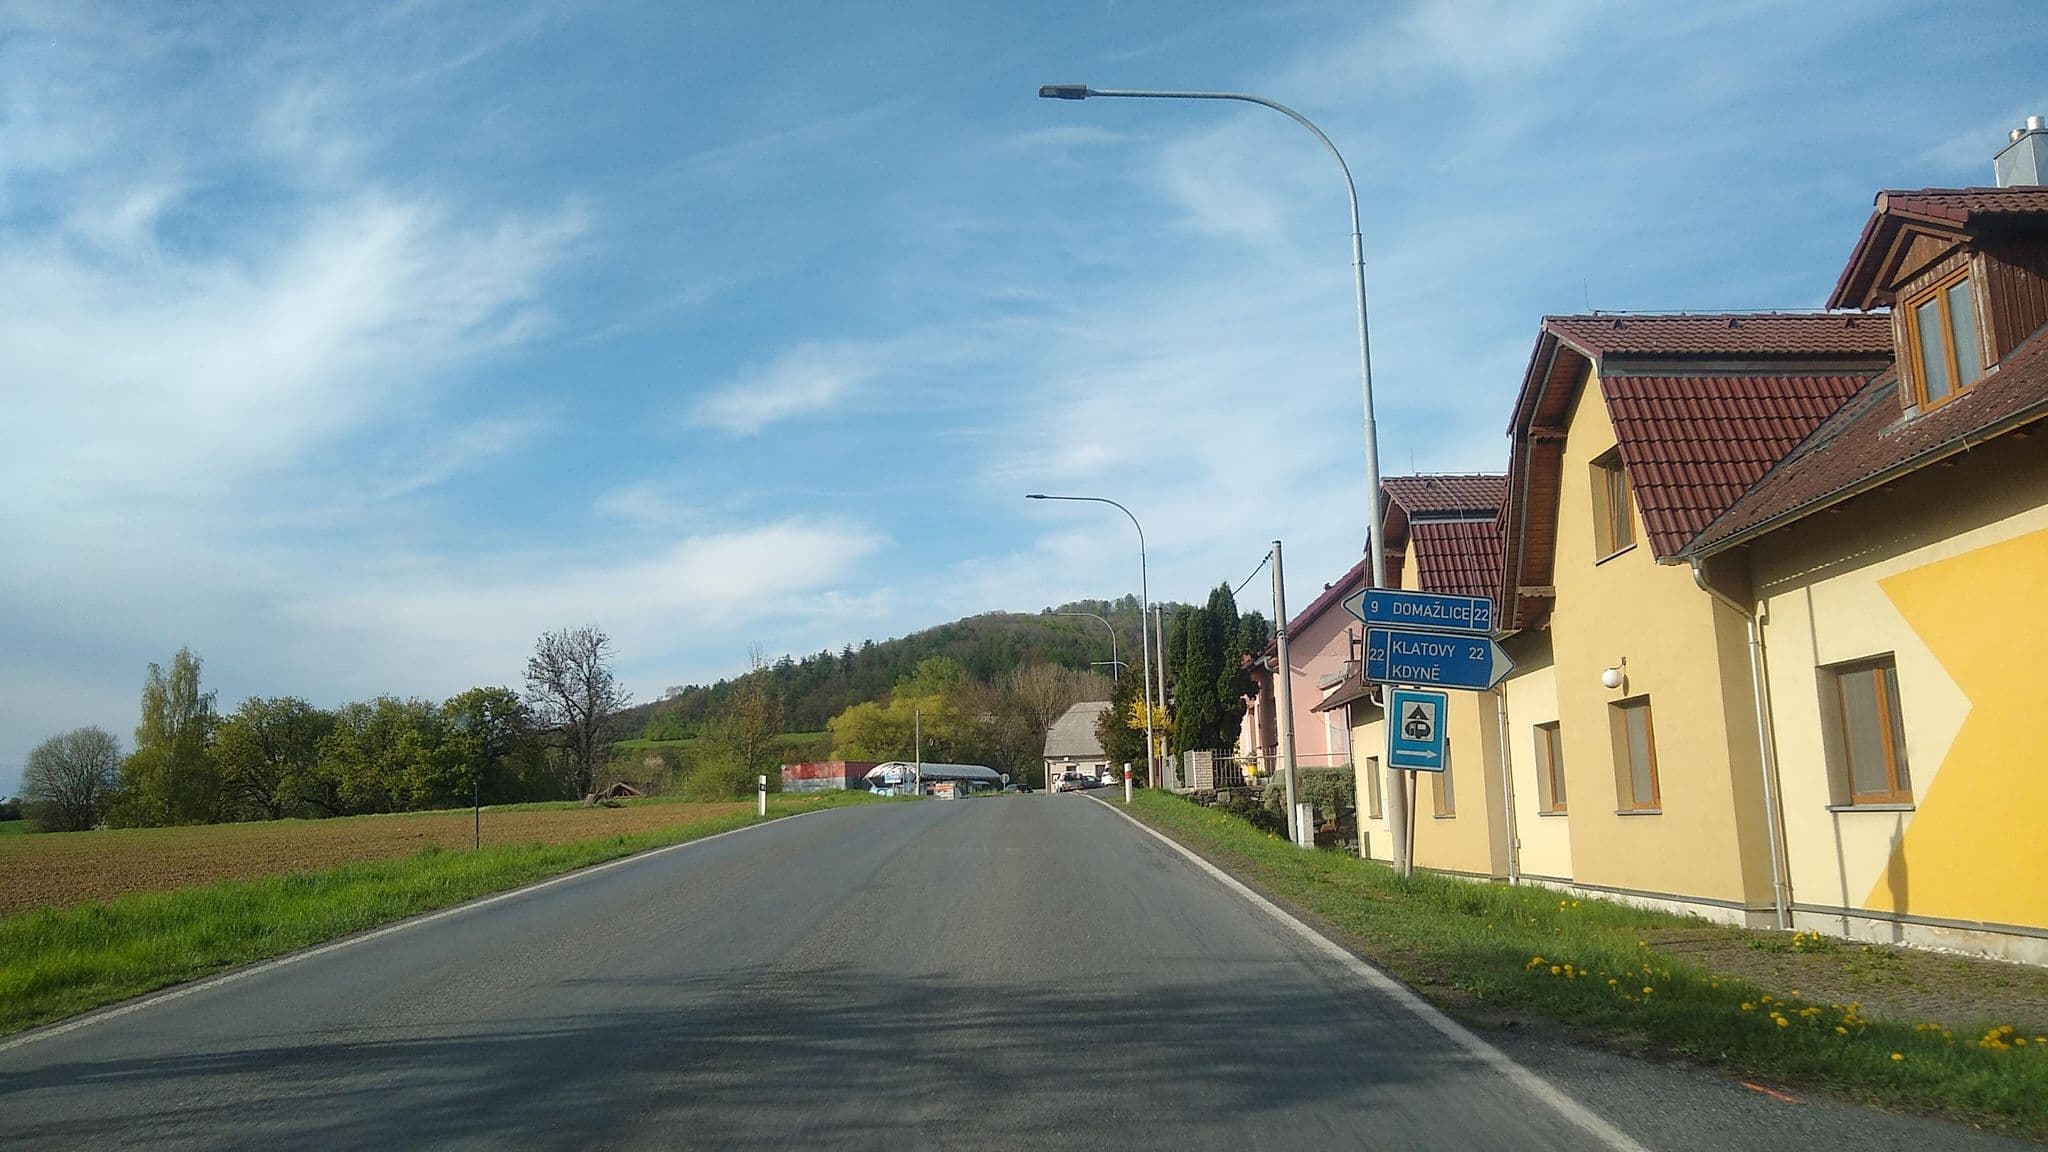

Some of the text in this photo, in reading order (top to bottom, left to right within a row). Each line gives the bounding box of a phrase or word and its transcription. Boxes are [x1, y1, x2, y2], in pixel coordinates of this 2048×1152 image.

[1371, 601, 1488, 621] 9 DOMAŽLICE 22
[1370, 641, 1484, 661] 22 KLATOVY 22
[1392, 664, 1440, 681] KDYNĚ
